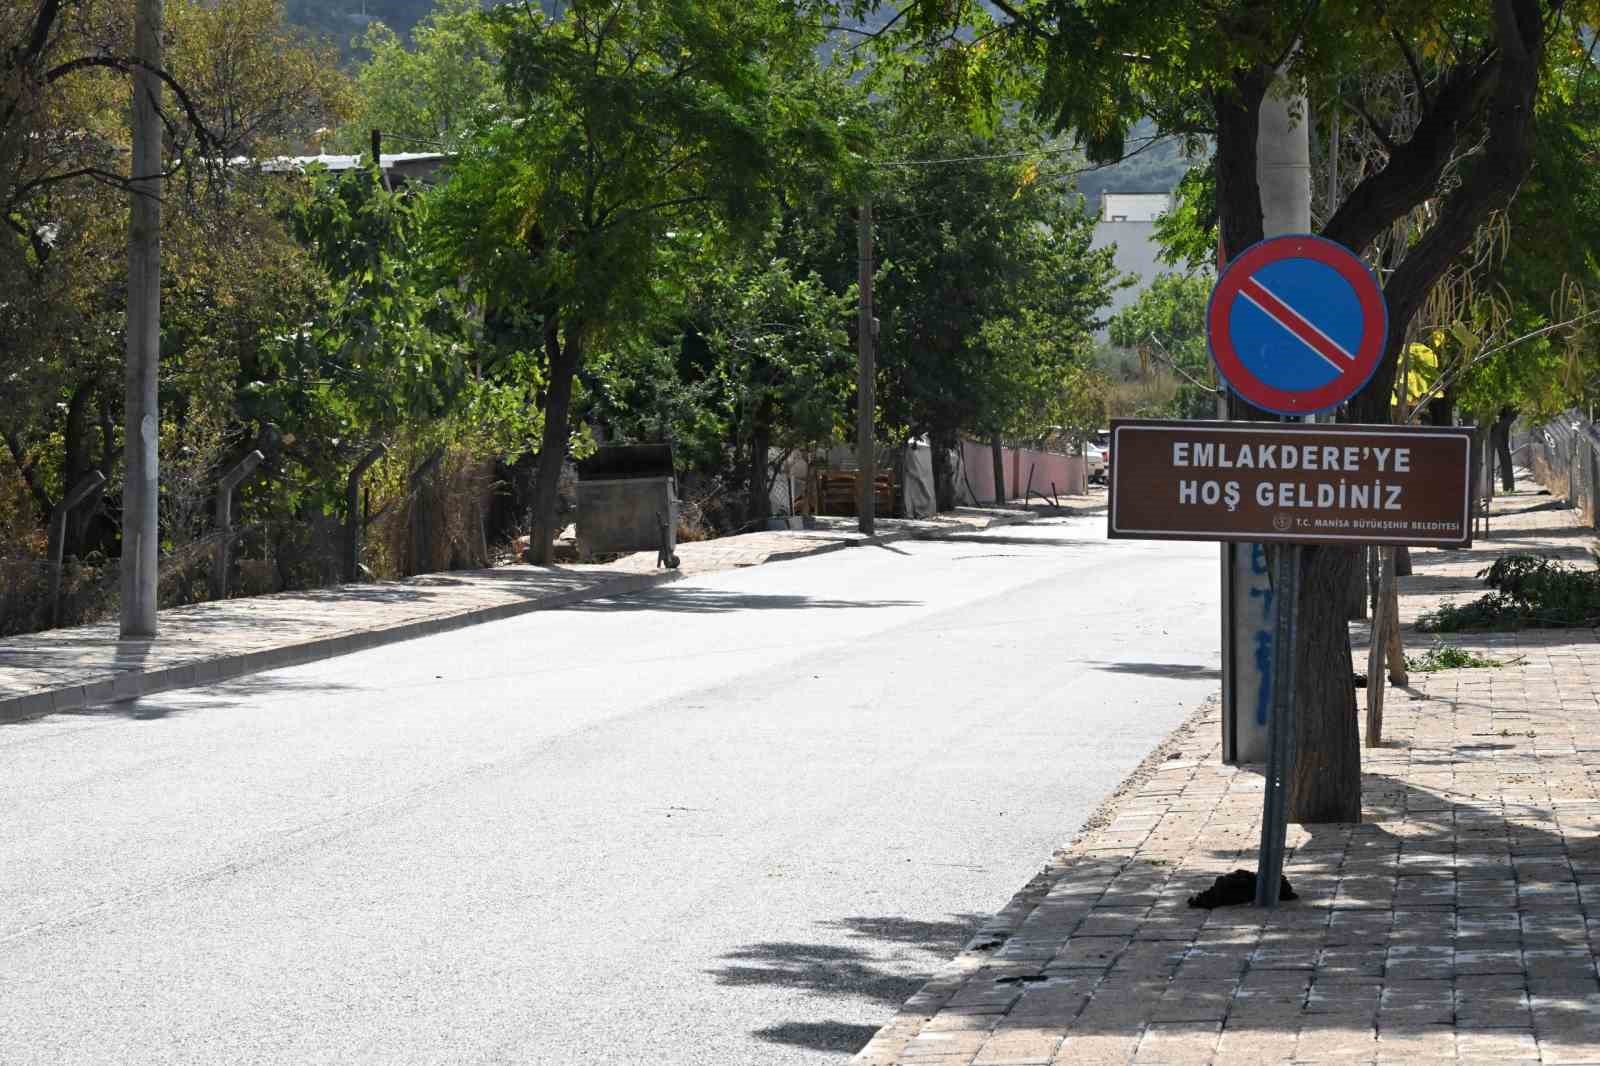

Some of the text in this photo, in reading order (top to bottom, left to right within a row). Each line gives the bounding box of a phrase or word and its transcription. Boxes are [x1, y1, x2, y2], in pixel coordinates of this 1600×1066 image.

[1172, 441, 1411, 473] EMLAKDERE'YE
[1179, 478, 1403, 512] HOŞ GELDİNİZ
[1295, 518, 1311, 528] T.C.
[1314, 518, 1350, 529] MANİSA
[1412, 520, 1460, 531] BELEDİYESİ
